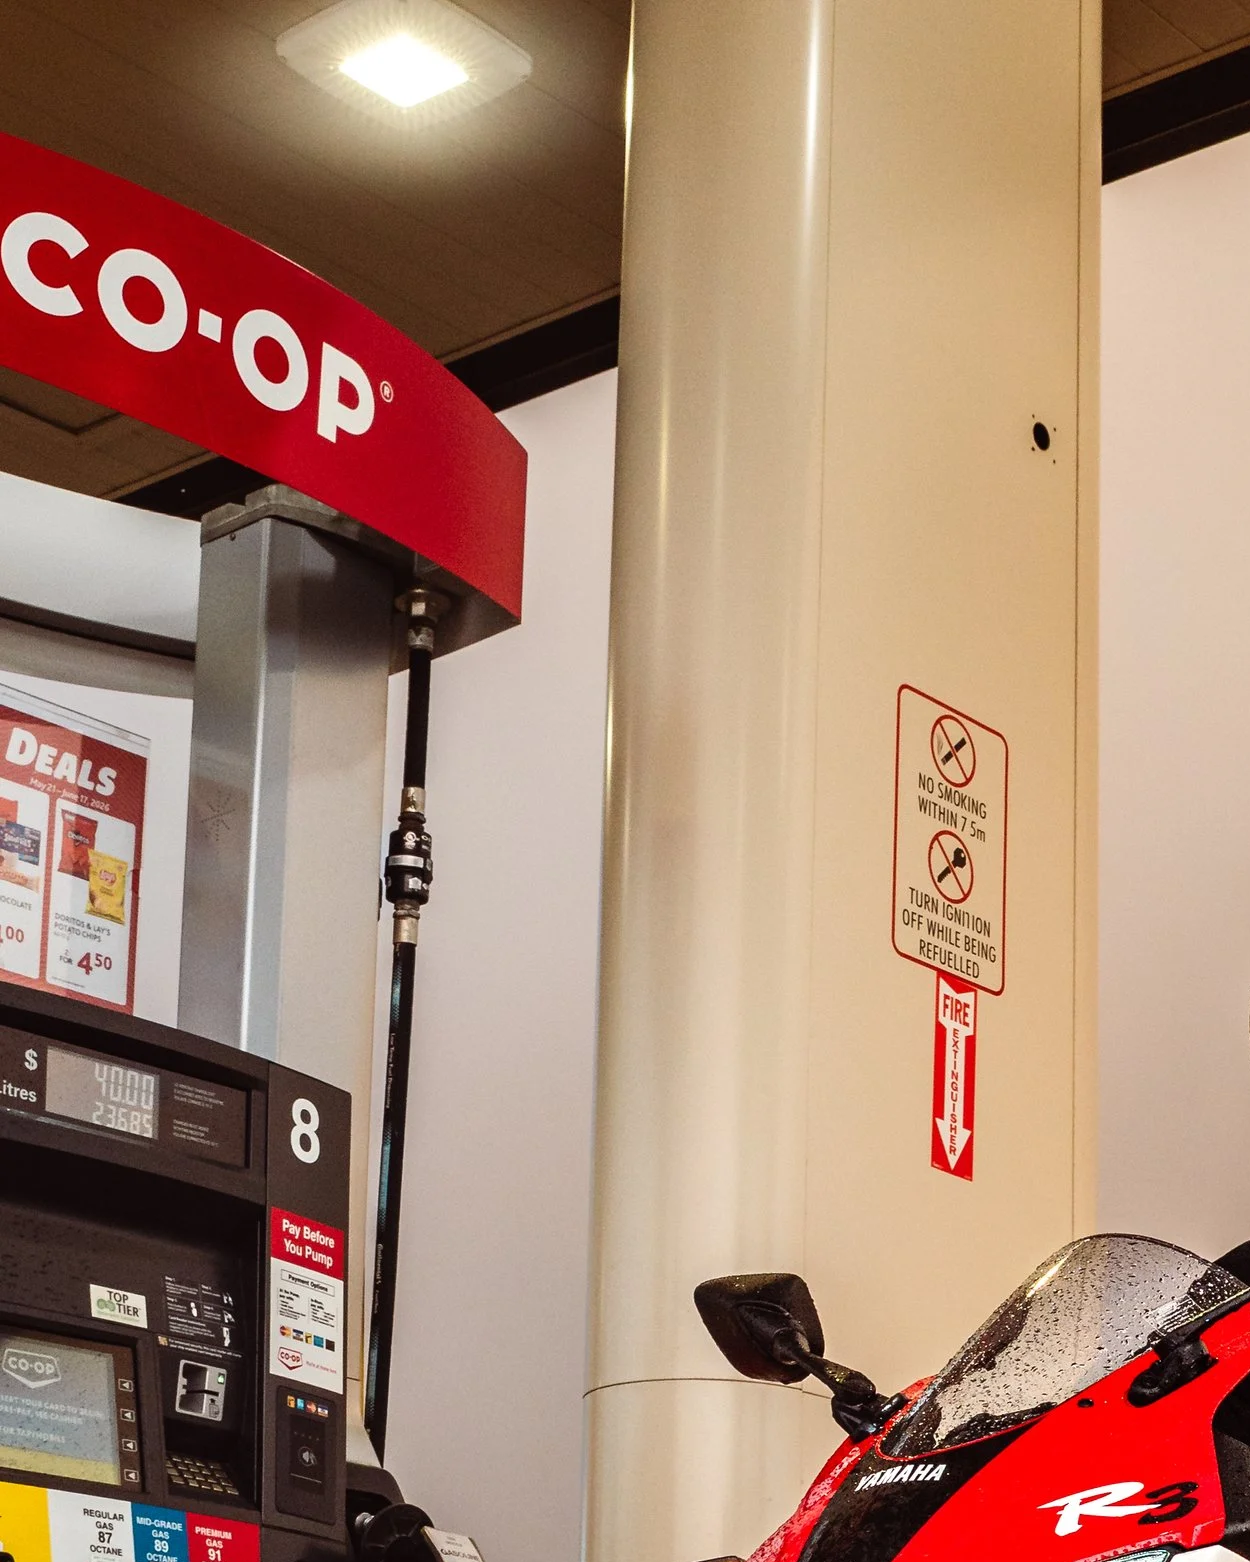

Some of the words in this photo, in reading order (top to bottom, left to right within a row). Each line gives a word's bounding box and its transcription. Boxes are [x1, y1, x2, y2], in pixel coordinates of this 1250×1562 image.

[1, 212, 374, 443] CO-OP
[5, 727, 117, 796] DEALS
[918, 772, 934, 794] NO
[938, 782, 987, 819] SMOKING
[918, 795, 957, 829] WITHIN
[55, 913, 84, 929] DORITOS
[909, 887, 938, 915] TURN
[943, 902, 990, 938] IGNITION
[54, 922, 81, 936] POTATO
[81, 930, 101, 942] CHIPS
[902, 909, 924, 931] OFF
[927, 918, 960, 948] WHILE
[964, 935, 996, 963] BEING
[919, 939, 980, 979] REFUELLED
[943, 994, 970, 1028] FIRE
[24, 1048, 38, 1071] $
[949, 1028, 960, 1156] EXTINGUISHER
[290, 1098, 320, 1164] 8
[282, 1218, 300, 1239] Pay
[303, 1226, 335, 1248] Before
[284, 1238, 302, 1256] You
[305, 1245, 333, 1269] Pump
[288, 1274, 309, 1286] Payment
[310, 1281, 328, 1292] Options
[107, 1290, 129, 1304] TOP
[116, 1303, 140, 1318] TIER
[8, 1356, 55, 1375] CO-OP
[280, 1351, 300, 1363] CO-OP
[44, 1402, 65, 1412] CARD
[855, 1464, 947, 1491] YAMAHA
[83, 1508, 125, 1521] REGULAR
[136, 1516, 183, 1531] MID-GRADE
[95, 1521, 114, 1530] GAS
[151, 1529, 170, 1540] GAS
[195, 1526, 232, 1540] PREMIUM
[98, 1531, 112, 1544] 87
[154, 1539, 169, 1553] 89
[205, 1538, 223, 1549] GAS
[90, 1544, 123, 1556] OCTANE
[208, 1548, 221, 1562] 91
